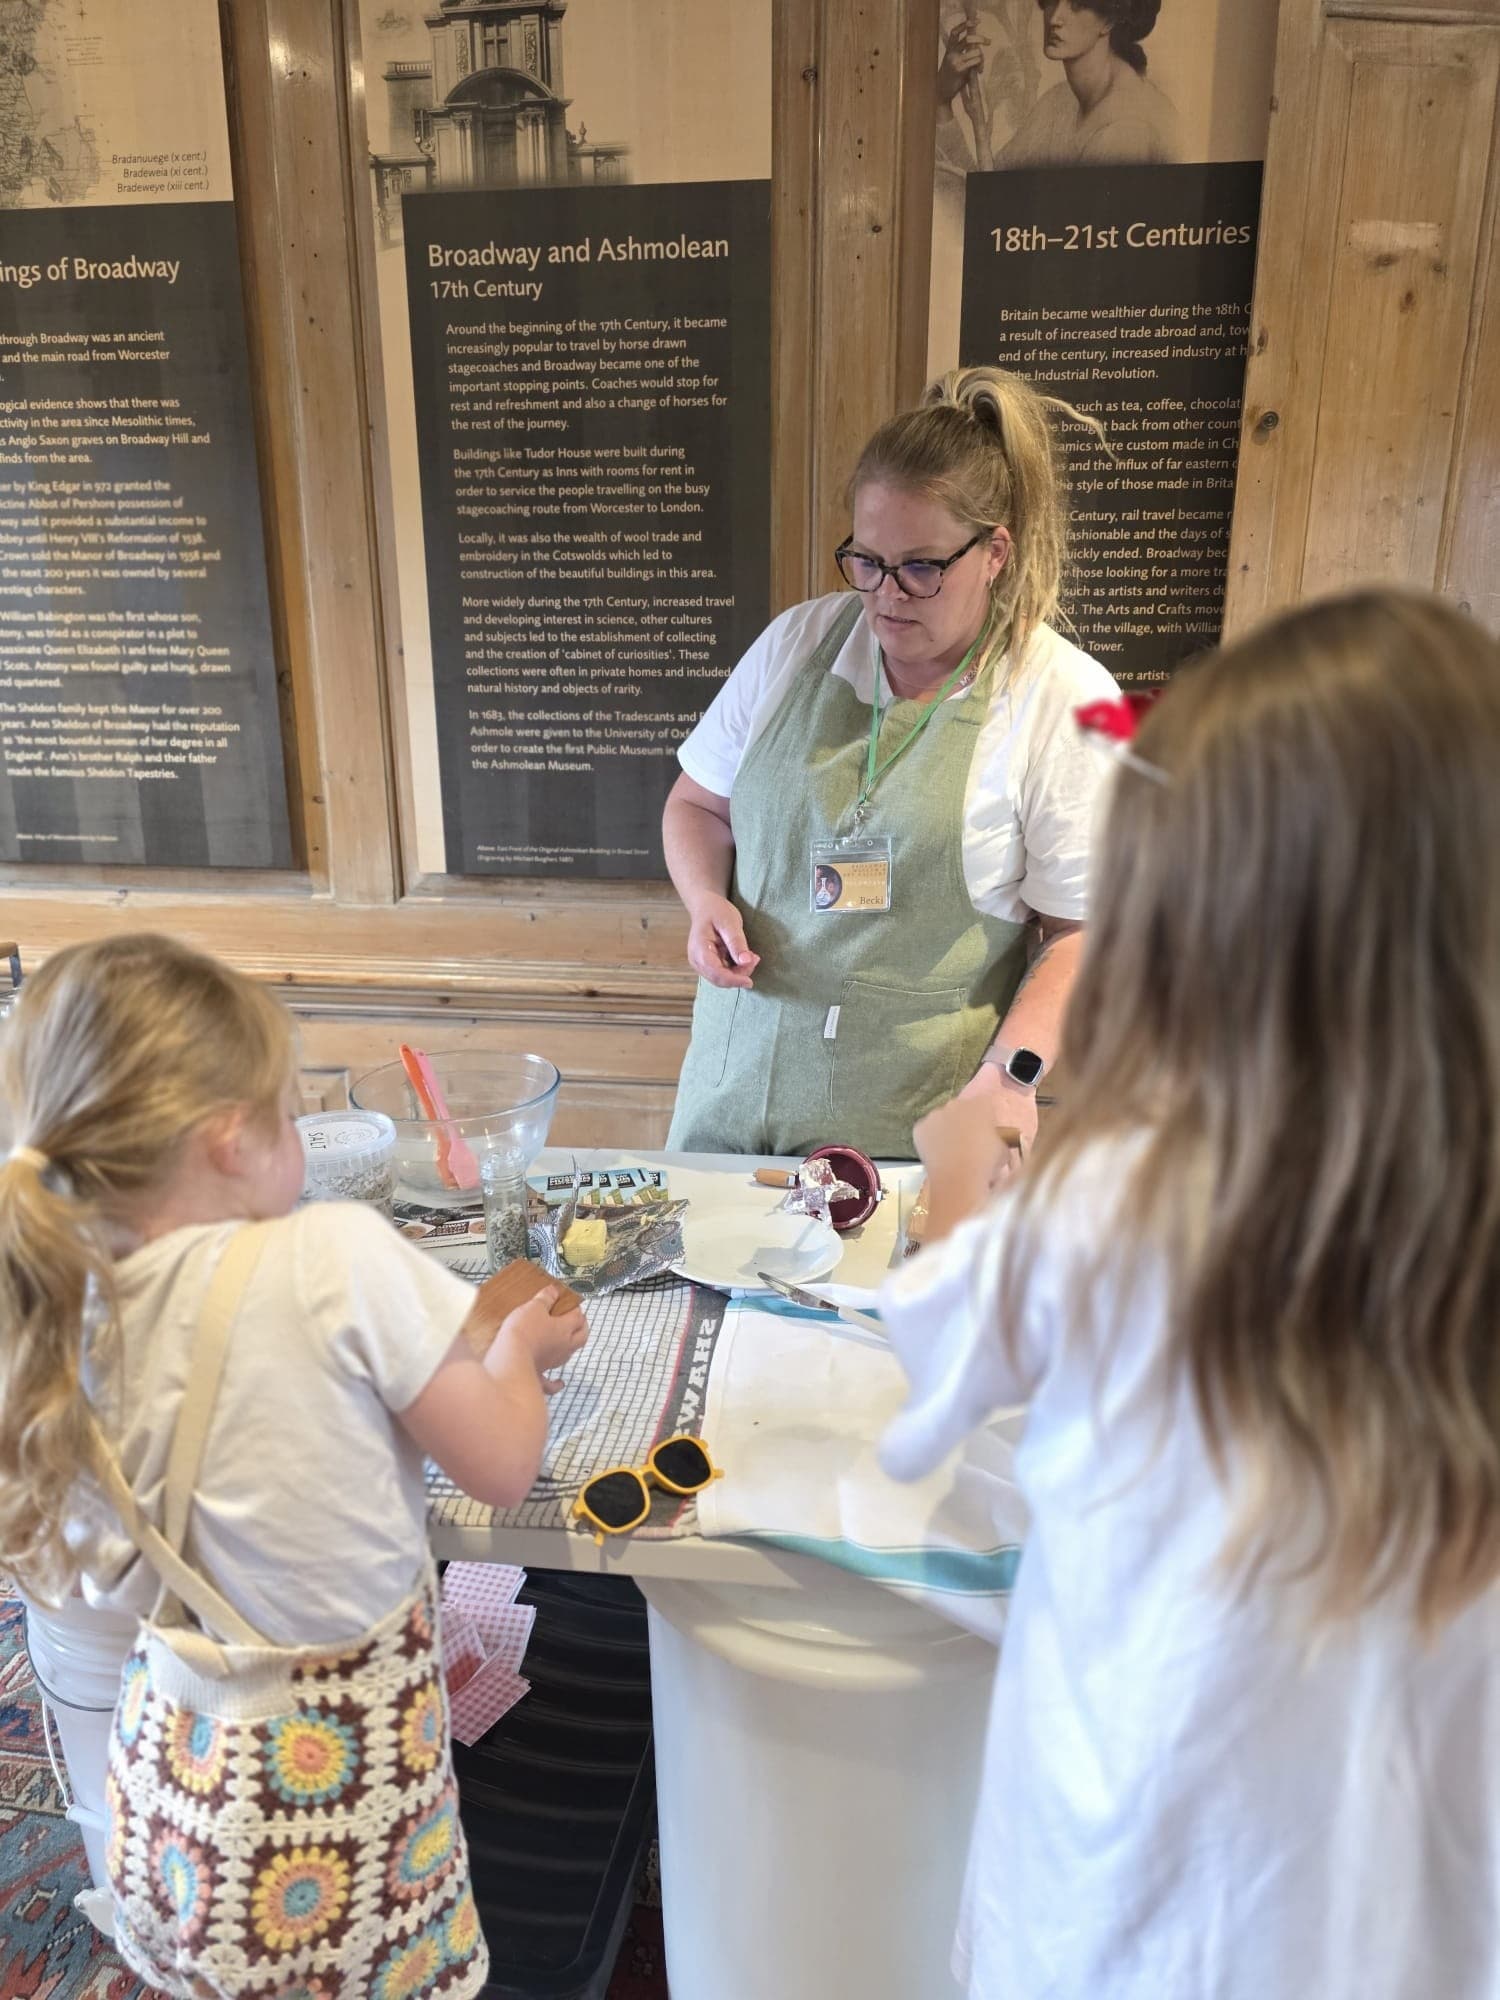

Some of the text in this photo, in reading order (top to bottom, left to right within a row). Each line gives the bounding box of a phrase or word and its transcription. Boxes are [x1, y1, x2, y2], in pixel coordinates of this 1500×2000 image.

[112, 149, 206, 167] Bradanuuege (x cent.)
[122, 164, 208, 180] Bradeweia (xi cent.)
[117, 178, 209, 196] Bradeweye (xiii cent.)
[990, 219, 1249, 251] 18th–21st Centuries
[428, 235, 728, 273] Broadway and Ashmolean
[46, 258, 68, 281] of
[73, 255, 180, 287] Broadway
[430, 278, 542, 303] 17th Century
[1000, 301, 1239, 321] Britain became wealthier during the 18th
[446, 315, 727, 336] Around the beginning of the 17th Century, it became
[999, 323, 1224, 341] a result of increased trade abroad and,
[40, 330, 89, 347] Broadway
[90, 334, 111, 343] was
[112, 333, 125, 342] an
[127, 329, 165, 342] ancient
[2, 347, 170, 362] and the main road from Worcester
[998, 342, 1236, 363] end of the century, increased industry at
[448, 355, 699, 377] stagecoaches and Broadway became one of the
[1032, 364, 1158, 380] Industrial Revolution.
[449, 374, 718, 395] important stopping points. Coaches would stop for
[1074, 396, 1186, 414] such as tea, coffee,
[451, 416, 569, 432] the rest of the journey.
[8, 431, 210, 448] Anglo Saxon graves on Broadway Hill and
[453, 444, 685, 462] Buildings like Tudor House were built during
[456, 500, 704, 518] stagecoaching route from Worcester to London.
[1068, 506, 1223, 524] Century, rail travel became
[458, 529, 702, 547] Locally, it was also the wealth of wool trade and
[460, 565, 716, 581] construction of the beautiful buildings in this area.
[1062, 582, 1209, 596] such as artists and writers
[1081, 600, 1191, 614] The Arts and Crafts
[1078, 619, 1182, 636] in the village, with
[1088, 638, 1124, 652] Tower.
[467, 680, 642, 697] natural history and objects of rarity.
[472, 756, 594, 770] the Ashmolean Museum.
[860, 896, 884, 905] Becki
[307, 1132, 327, 1149] SALT
